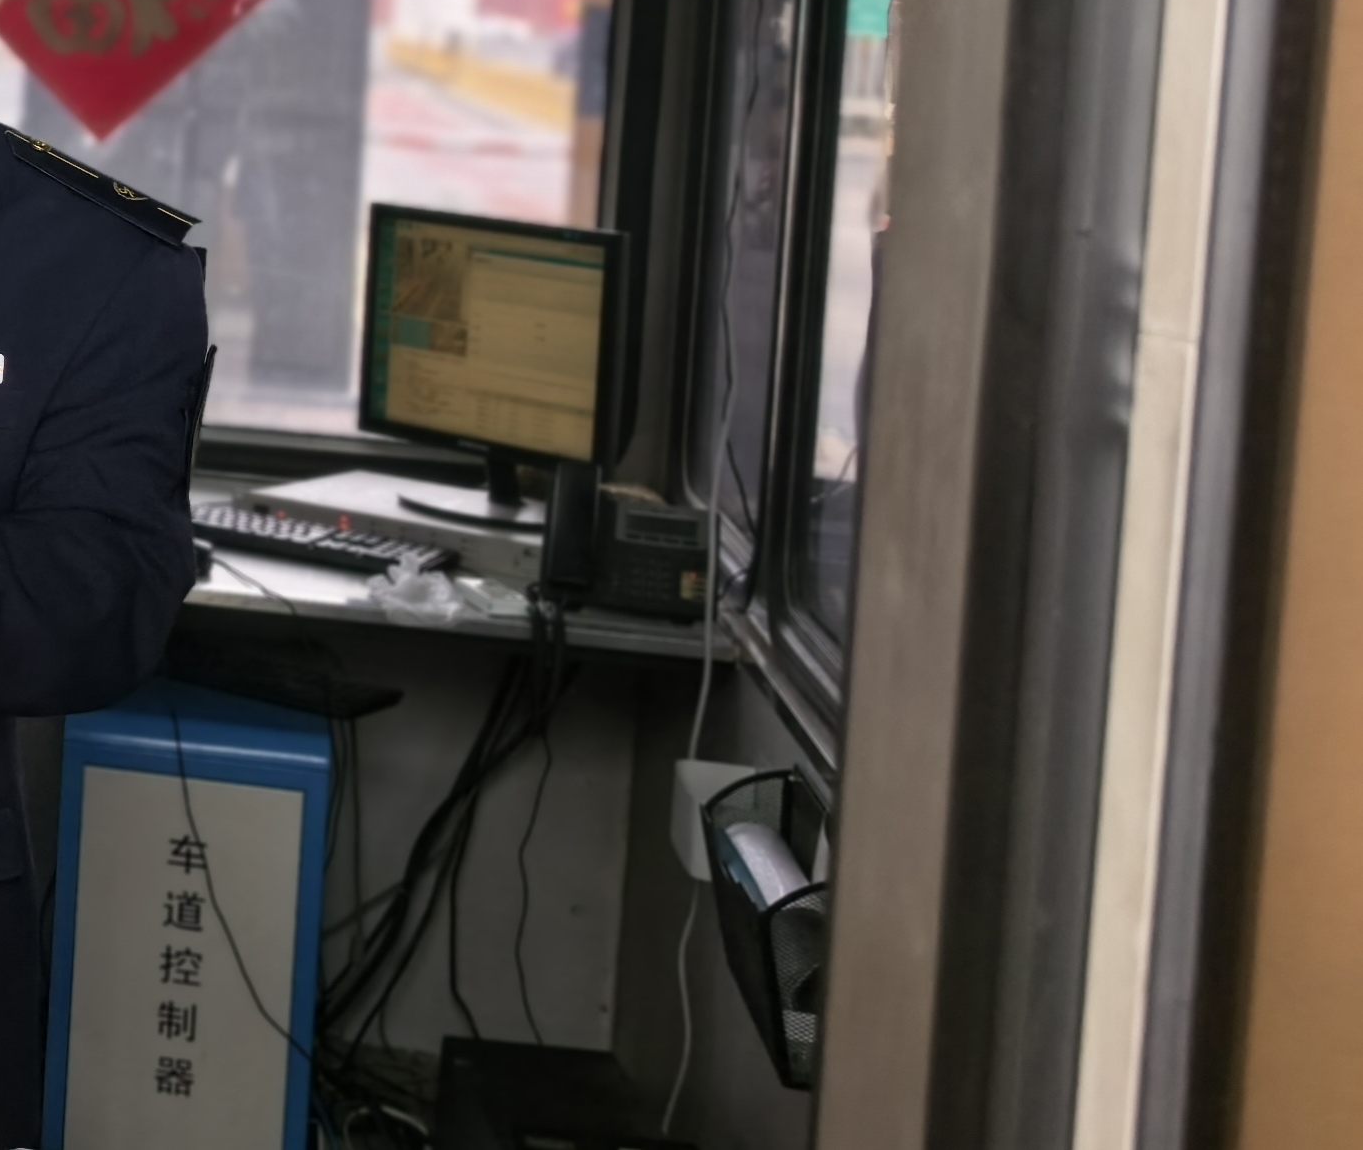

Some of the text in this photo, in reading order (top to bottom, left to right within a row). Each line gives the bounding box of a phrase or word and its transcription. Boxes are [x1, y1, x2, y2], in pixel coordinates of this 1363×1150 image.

[155, 835, 207, 1097] 车道控制器
